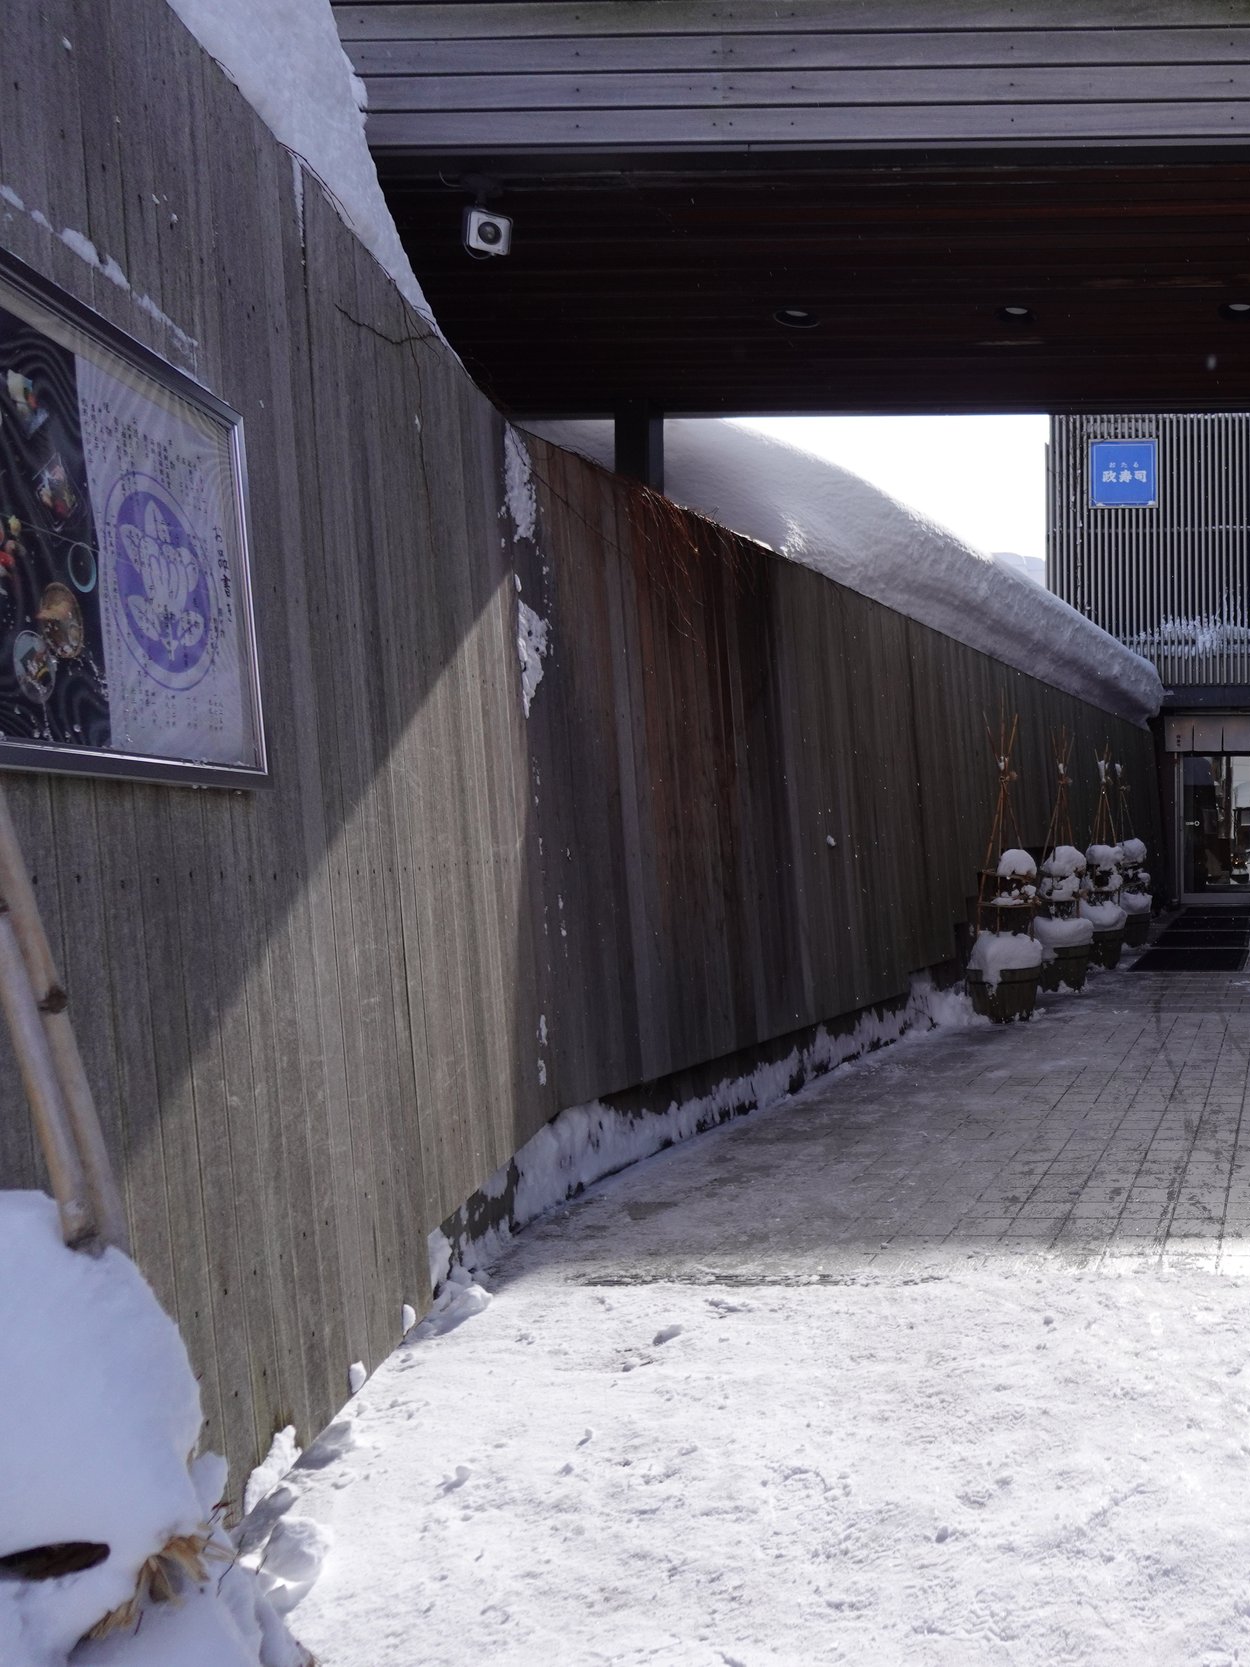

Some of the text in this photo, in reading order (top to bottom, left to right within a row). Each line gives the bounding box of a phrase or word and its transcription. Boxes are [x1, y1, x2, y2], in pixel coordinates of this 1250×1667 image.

[1108, 461, 1140, 469] おたる
[1101, 470, 1148, 484] 政寿司
